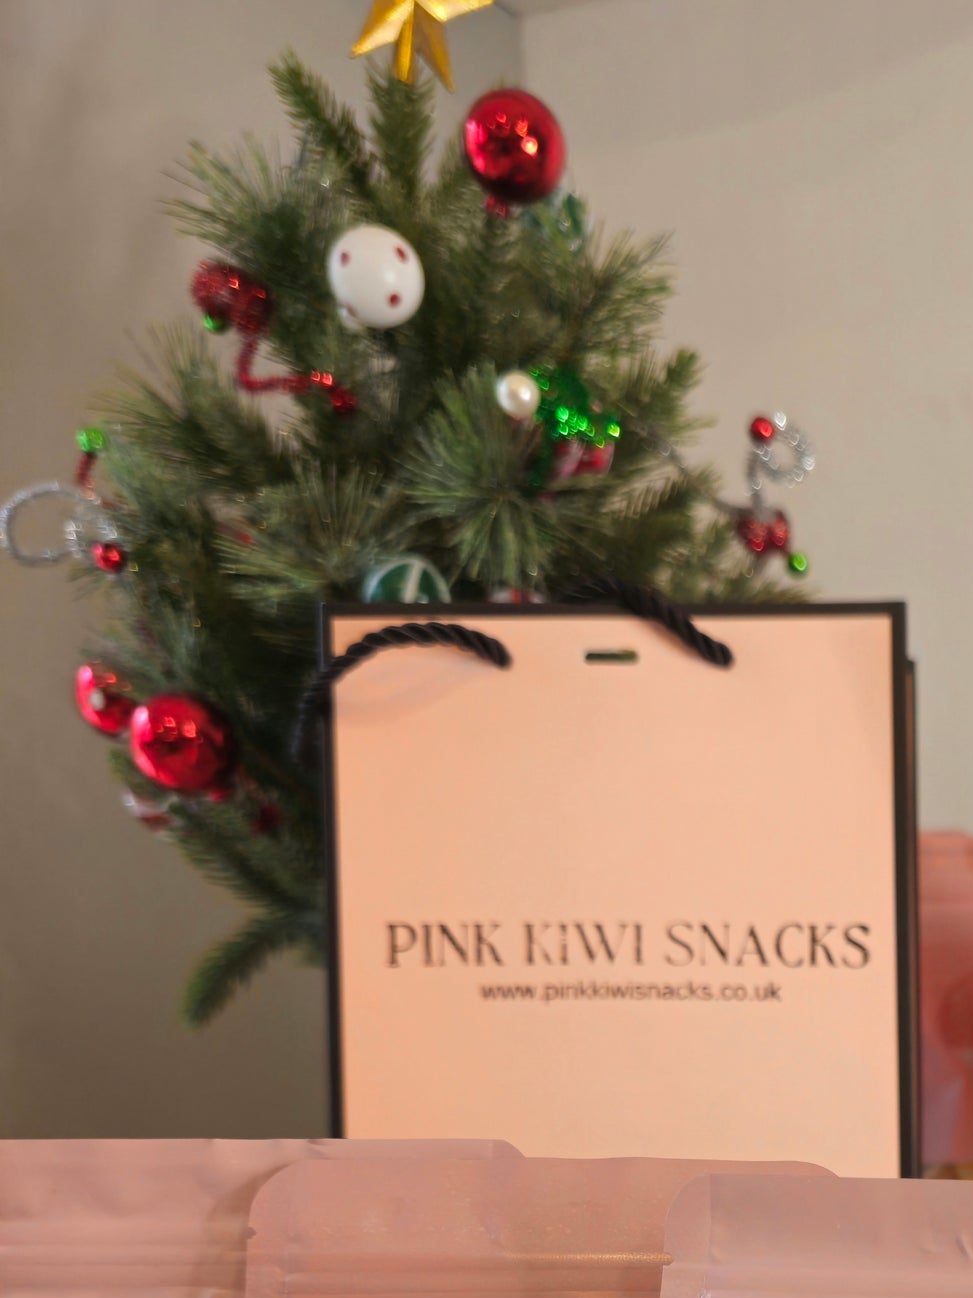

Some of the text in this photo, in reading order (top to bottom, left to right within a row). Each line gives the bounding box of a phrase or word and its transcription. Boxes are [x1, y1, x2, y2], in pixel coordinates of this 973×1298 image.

[384, 920, 872, 969] PINK KIWI SNACKS
[479, 980, 784, 1004] www.pinkkiwisnacks.co.uk
